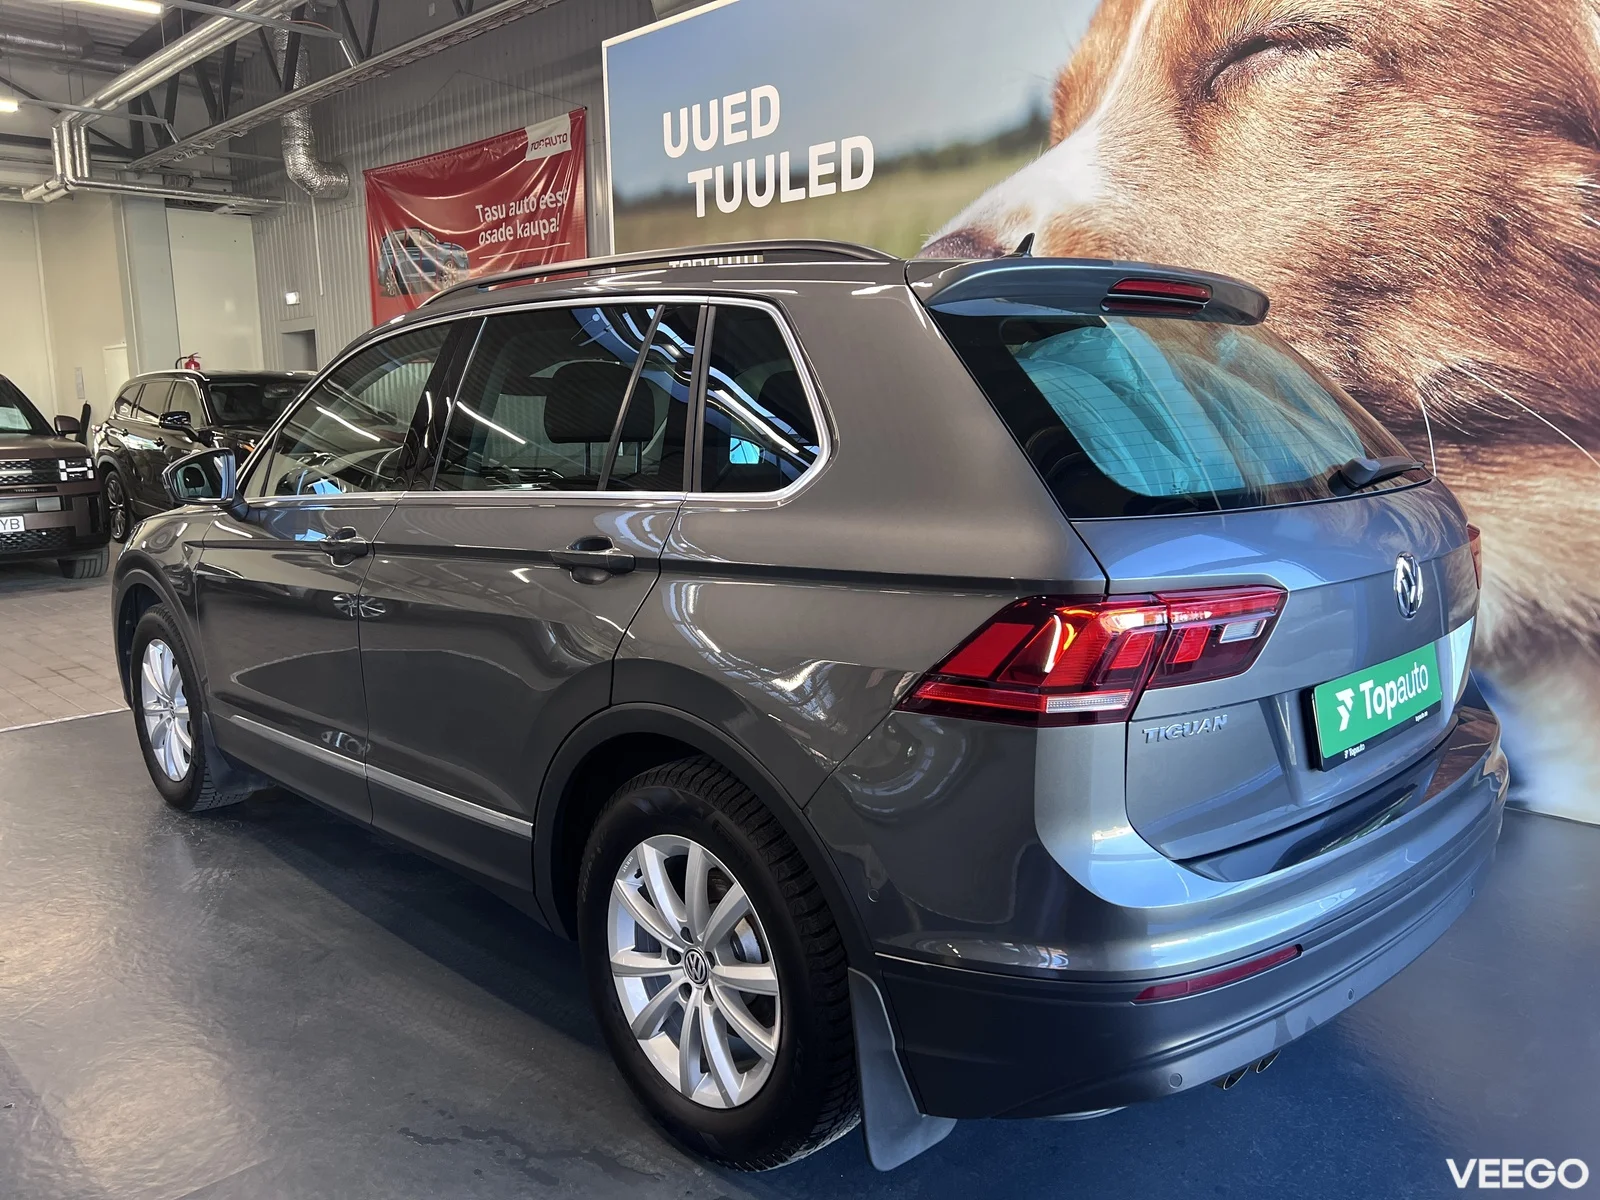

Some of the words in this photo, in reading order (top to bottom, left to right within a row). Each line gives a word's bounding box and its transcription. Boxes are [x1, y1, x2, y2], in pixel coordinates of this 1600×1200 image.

[663, 84, 780, 158] UUED
[687, 135, 875, 218] TUULED
[475, 203, 506, 223] Tasu
[509, 195, 538, 217] auto
[539, 189, 568, 210] eest
[478, 221, 514, 246] osade
[516, 212, 560, 240] kaupa!
[1359, 662, 1429, 720] Topauto
[1142, 714, 1228, 743] TIGUAN
